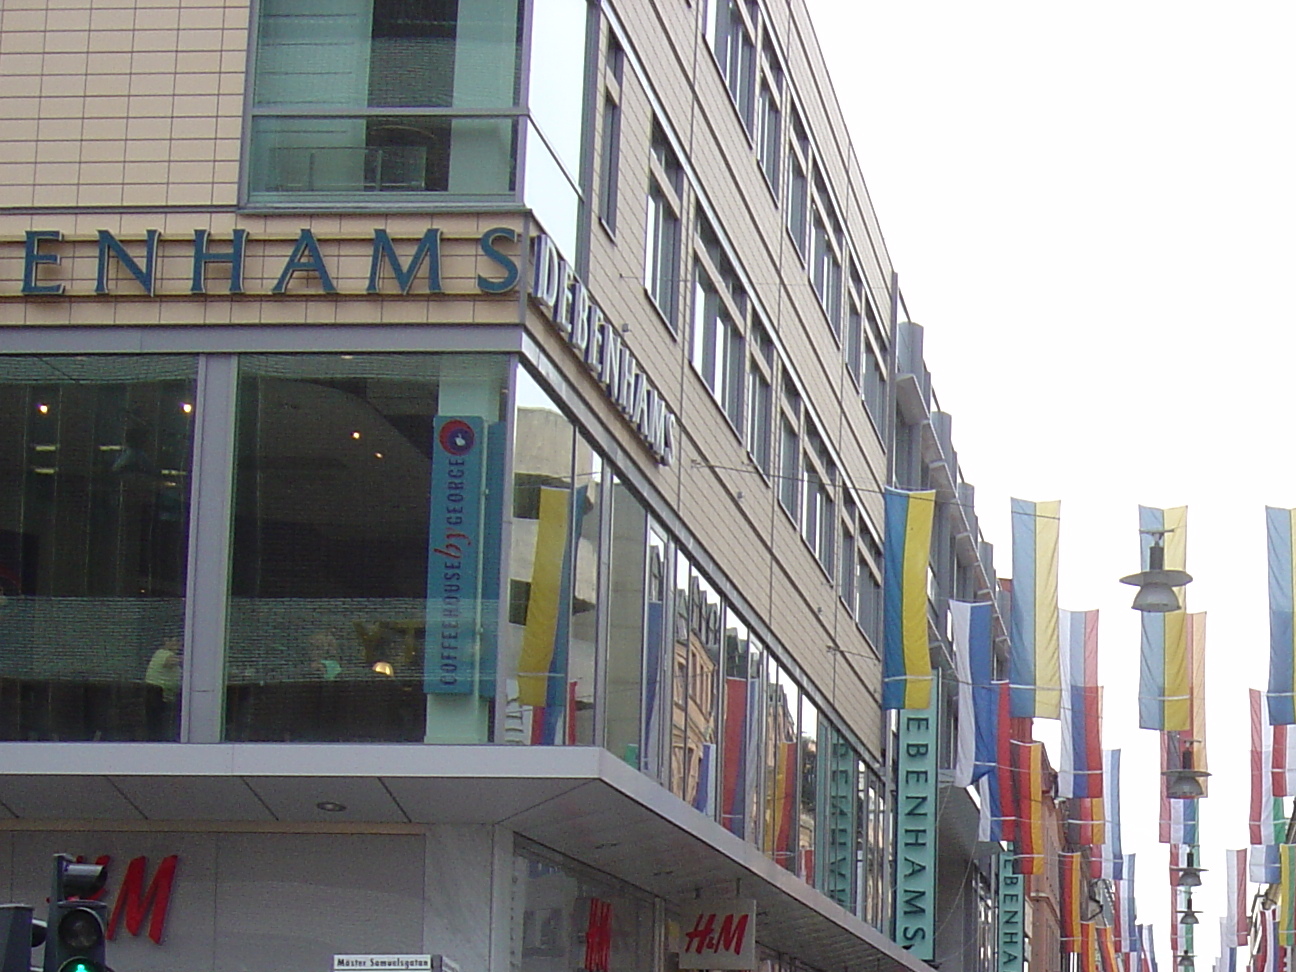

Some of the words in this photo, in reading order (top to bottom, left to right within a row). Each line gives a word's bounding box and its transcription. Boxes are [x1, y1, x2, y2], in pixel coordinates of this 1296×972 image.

[532, 233, 676, 467] DEBENHAMS
[446, 457, 465, 526] GEORGE
[439, 561, 462, 687] COFFEEHOUSE
[903, 715, 930, 941] EBENHAMS
[685, 913, 749, 956] H&M
